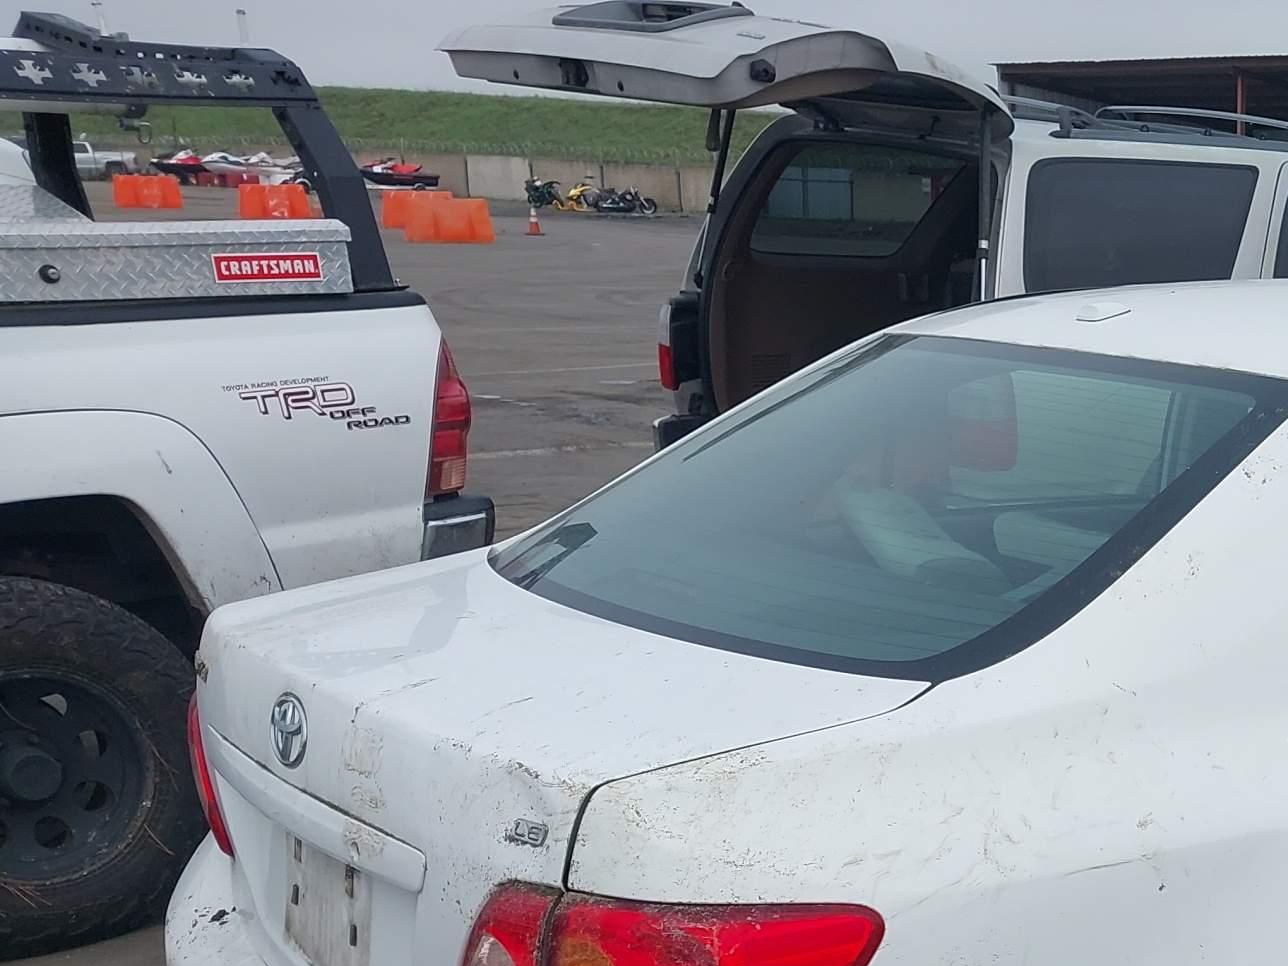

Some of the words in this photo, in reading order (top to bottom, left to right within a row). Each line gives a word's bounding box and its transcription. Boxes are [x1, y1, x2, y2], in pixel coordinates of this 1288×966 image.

[222, 384, 249, 392] TOYOTA
[250, 382, 279, 390] RACING
[279, 376, 329, 387] DEVELOPMENT
[239, 382, 355, 420] TRD
[329, 406, 377, 420] OFF
[346, 415, 411, 431] ROAD
[514, 820, 545, 844] LE
